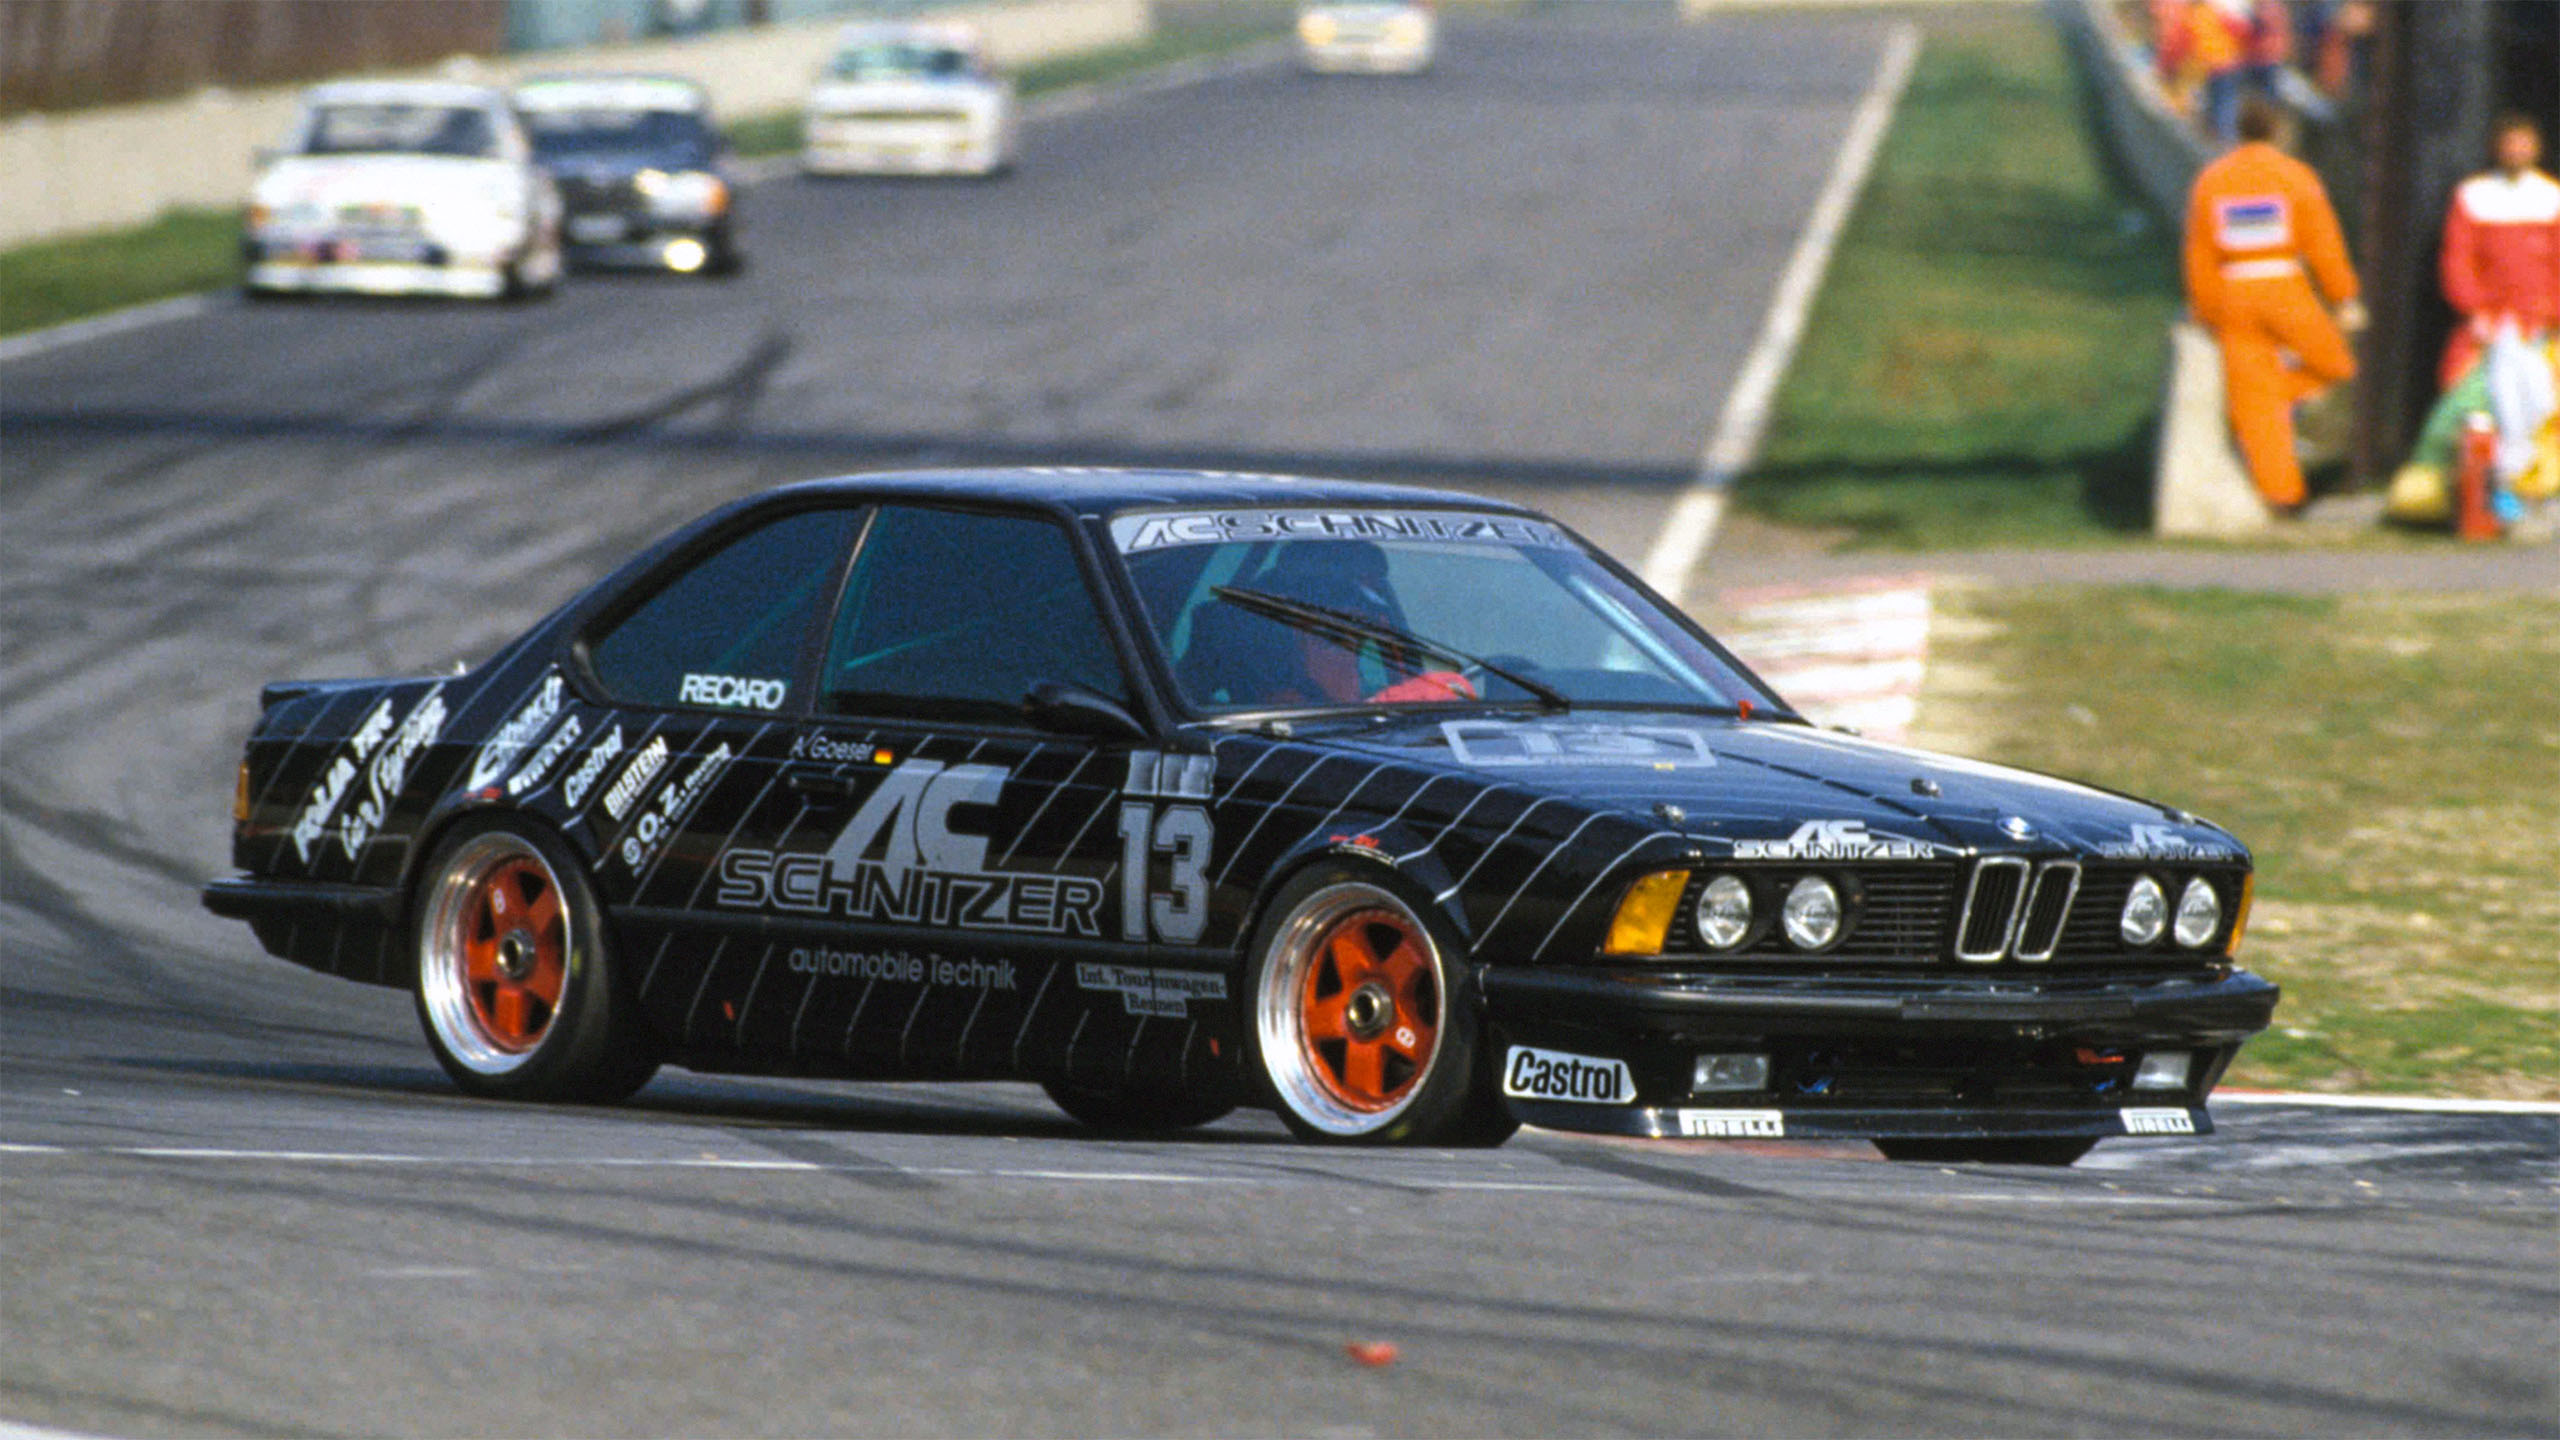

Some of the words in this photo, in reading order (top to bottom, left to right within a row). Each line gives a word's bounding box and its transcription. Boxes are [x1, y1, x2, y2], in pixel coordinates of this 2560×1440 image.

[1129, 514, 1223, 549] AC
[680, 674, 786, 710] RECARO
[564, 723, 624, 809] Castrol
[604, 734, 669, 816] BILSTEIN
[826, 757, 1011, 884] AC
[1787, 819, 1871, 849] AC
[1117, 801, 1215, 945] 13
[1732, 839, 1935, 860] SCHNITZER
[717, 847, 1104, 936] SCHNITZER
[789, 945, 924, 983] automobile
[930, 953, 1017, 991] Technik
[1509, 1049, 1622, 1100] Castrol
[1681, 1113, 1783, 1136] PIRELLI
